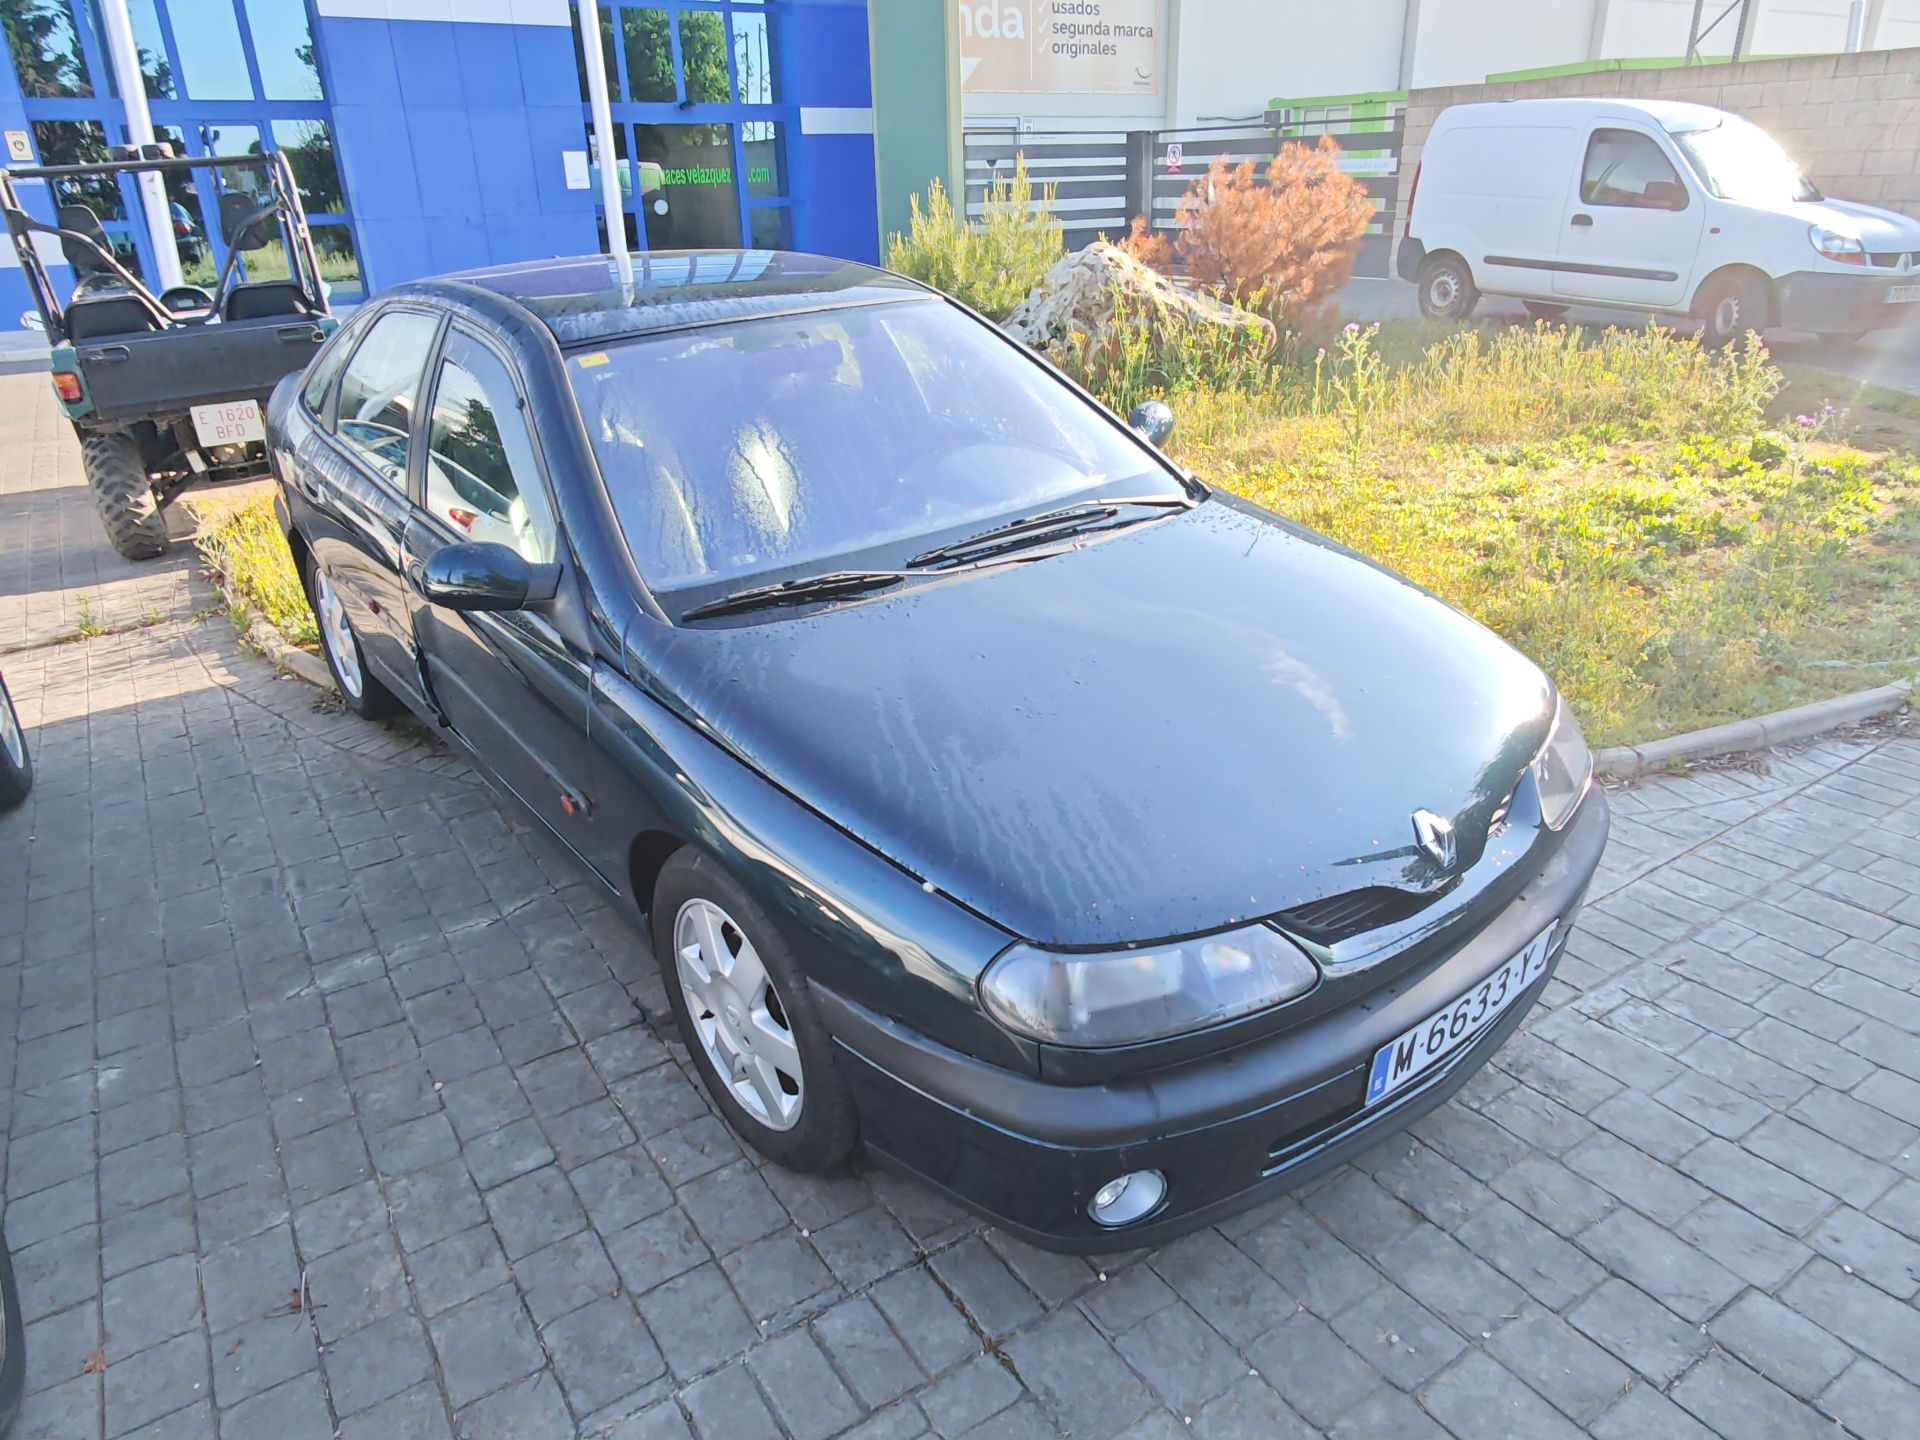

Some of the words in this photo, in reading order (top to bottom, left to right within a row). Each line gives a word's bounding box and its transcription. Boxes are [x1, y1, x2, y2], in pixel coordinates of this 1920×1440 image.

[1052, 0, 1100, 16] usados
[1052, 20, 1110, 38] segunda
[1113, 27, 1154, 38] marca
[1052, 41, 1117, 58] originales
[217, 406, 255, 422] 1620
[216, 423, 245, 439] BFD
